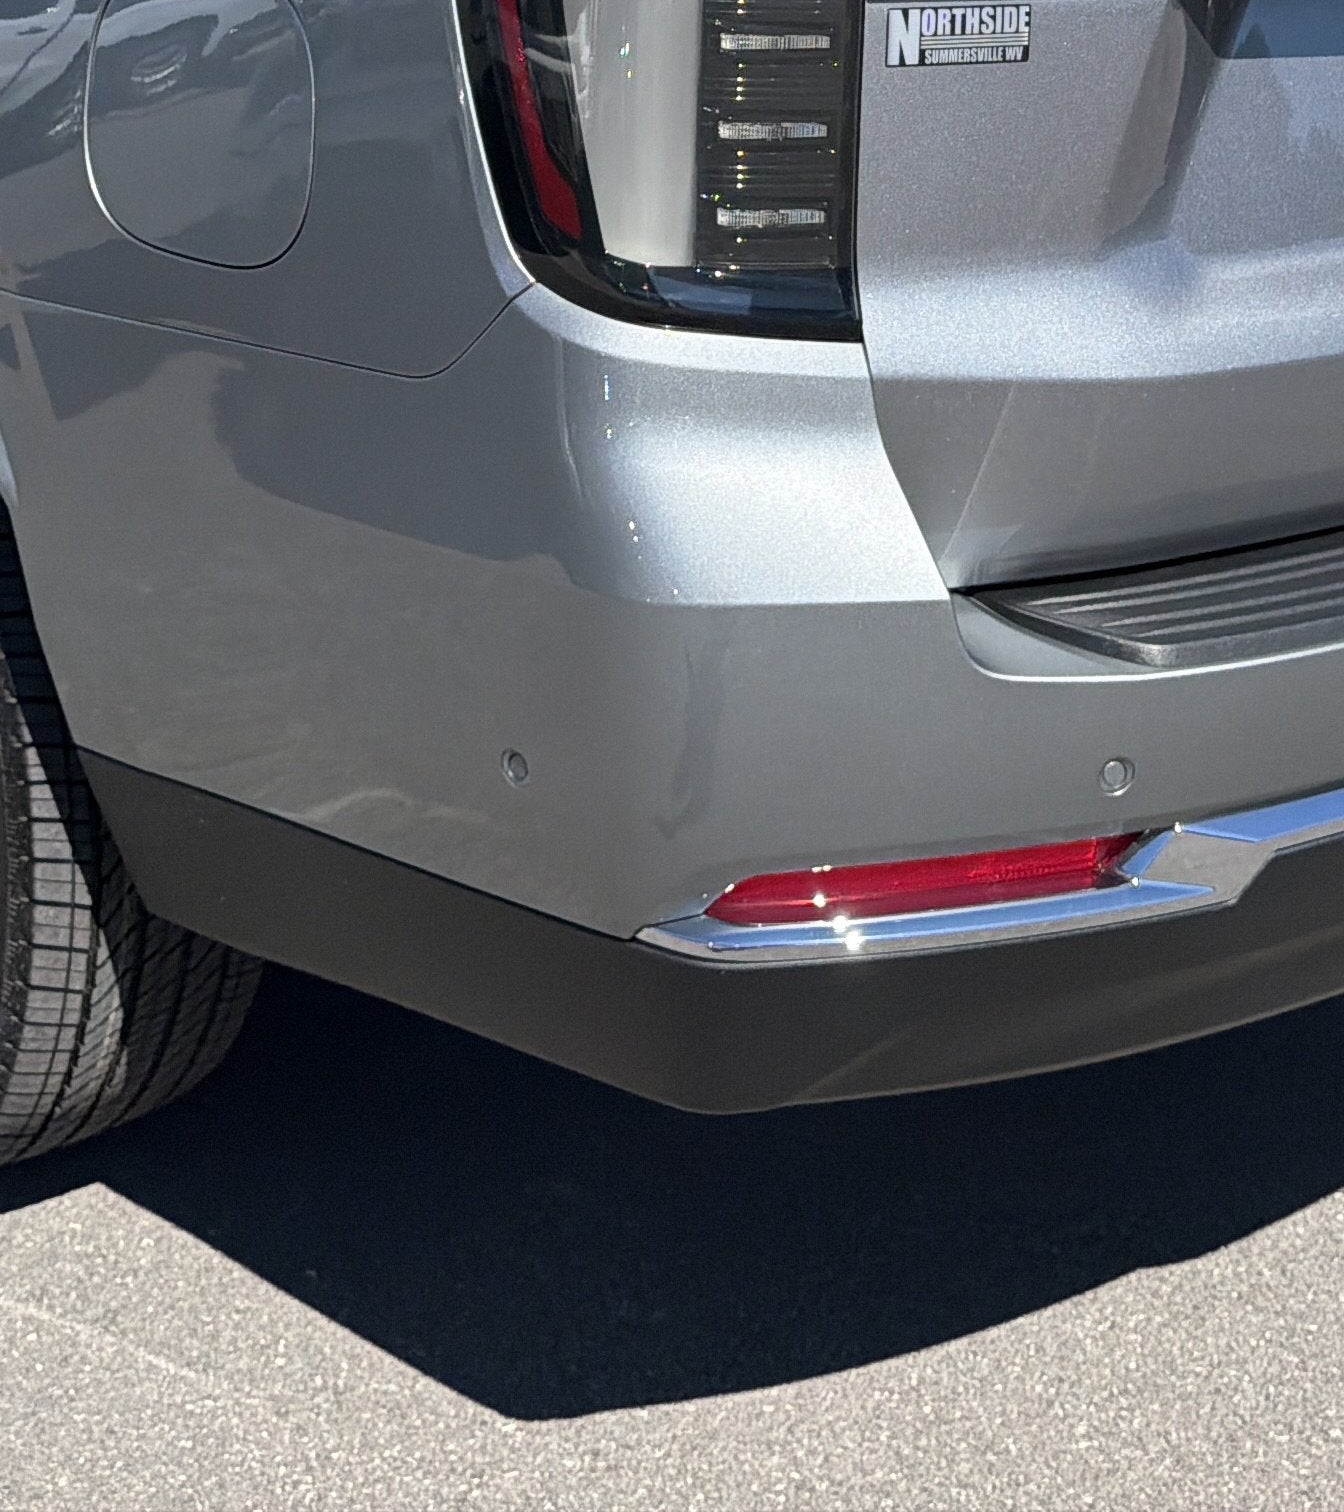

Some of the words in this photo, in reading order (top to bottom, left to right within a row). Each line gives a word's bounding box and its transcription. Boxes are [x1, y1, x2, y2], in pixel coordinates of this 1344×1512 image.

[886, 5, 1031, 66] NORTHSIDE
[924, 47, 1003, 65] SUMMERSVILLE
[1005, 45, 1024, 61] WV
